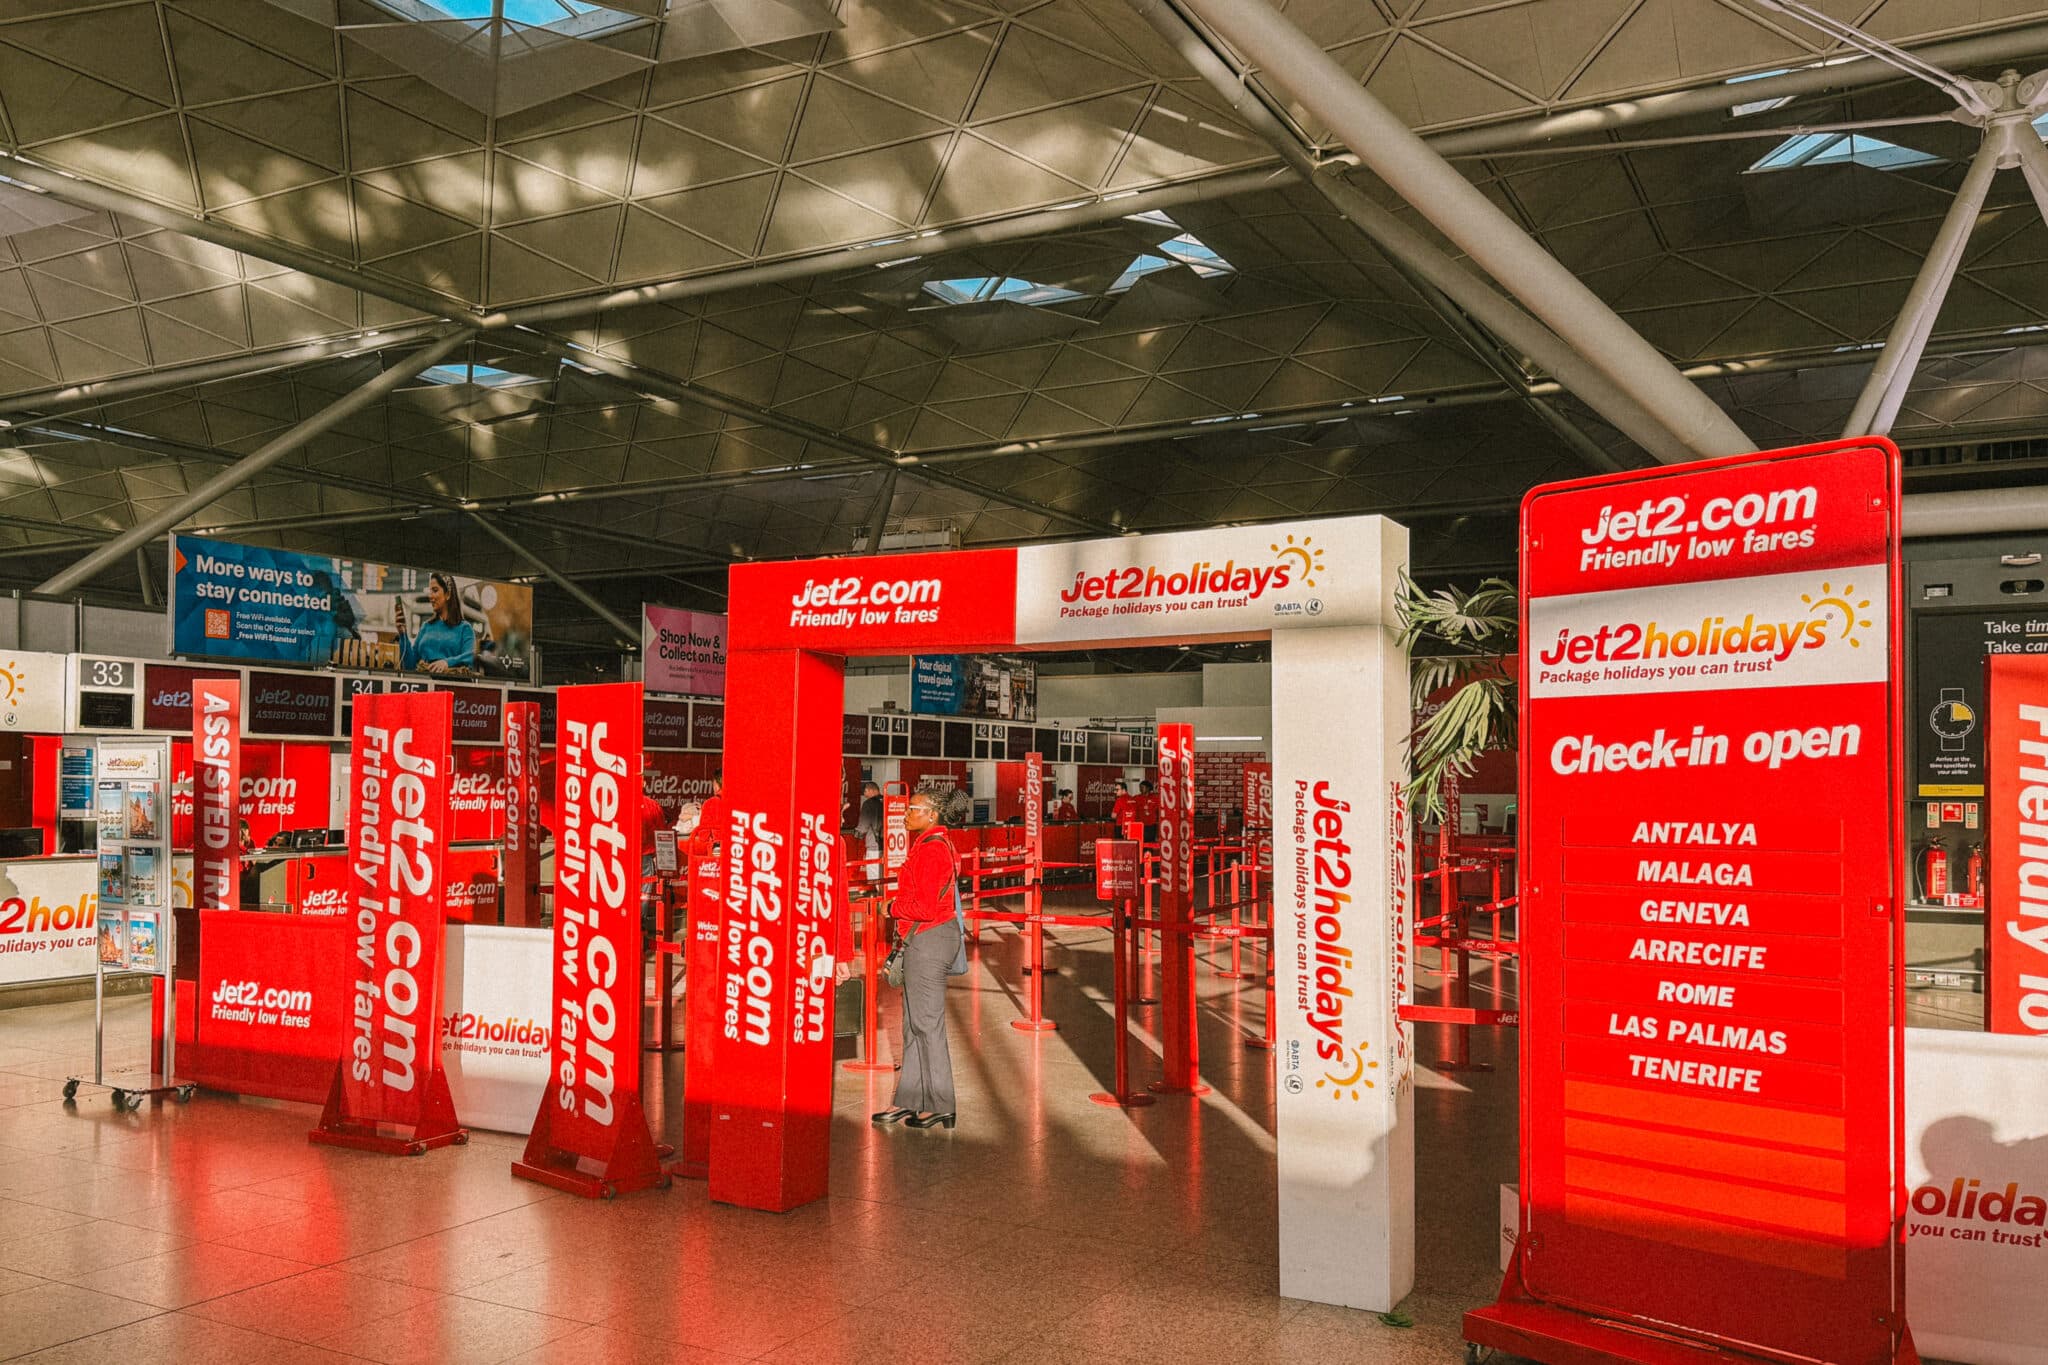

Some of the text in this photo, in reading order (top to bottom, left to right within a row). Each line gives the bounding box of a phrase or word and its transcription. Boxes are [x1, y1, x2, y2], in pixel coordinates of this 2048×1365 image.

[1581, 486, 1818, 545] Jet2.com
[1579, 525, 1816, 571] Friendly low fares
[196, 555, 314, 587] More ways to
[1060, 560, 1290, 603] Jet2holidays
[196, 582, 331, 611] stay connected
[792, 577, 942, 607] Jet2.com
[1060, 594, 1248, 618] Package holidays you can trust
[264, 624, 273, 632] QR
[790, 606, 940, 629] Friendly low fares
[1984, 620, 2020, 634] Take
[660, 628, 720, 648] Shop Now &
[1540, 614, 1827, 666] Jet2holidays
[1984, 640, 2021, 653] Take
[660, 646, 726, 664] Collect on Re
[918, 659, 952, 674] Your digital
[92, 662, 123, 686] 33
[918, 674, 952, 687] travel guide
[1540, 657, 1773, 684] Package holidays you can trust
[255, 688, 330, 708] Jet2.com
[256, 710, 328, 721] ASSISTED TRAVEL
[875, 718, 886, 730] 40
[895, 719, 904, 732] 41
[978, 725, 987, 737] 42
[994, 726, 1003, 738] 43
[1550, 724, 1861, 775] Check-in open
[204, 691, 230, 849] ASSISTED
[507, 712, 521, 850] Jet2.com
[529, 712, 540, 849] Jet2.com
[645, 776, 712, 794] Jet2.com
[1026, 759, 1040, 837] Jet2.com
[1246, 771, 1258, 818] Friendly
[258, 799, 296, 814] fares
[449, 796, 488, 812] riendly
[1160, 737, 1176, 892] Jet2.com
[1180, 737, 1193, 893] Jet2.com
[1632, 821, 1758, 846] ANTALYA
[1637, 860, 1754, 886] MALAGA
[353, 726, 388, 1082] Friendly low fares
[1292, 780, 1310, 1010] Package holidays you can trust
[383, 729, 435, 1092] Jet2.com
[559, 720, 587, 1111] Friendly low fares
[586, 722, 626, 1126] Jet2.com
[1306, 780, 1353, 1062] Jet2holidays
[1640, 899, 1750, 927] GENEVA
[724, 810, 750, 1042] Friendly low fares
[746, 813, 782, 1046] Jet2.com
[794, 812, 814, 1044] Friendly low fares
[50, 938, 74, 952] you
[1629, 938, 1768, 970] ARRECIFE
[212, 979, 312, 1012] Jet2.com
[1657, 980, 1736, 1008] ROME
[212, 1004, 311, 1028] Friendly low fares
[1608, 1013, 1788, 1055] LAS PALMAS
[454, 1041, 542, 1058] holidays you can trust
[1629, 1054, 1762, 1093] TENERIFE
[1912, 1177, 2048, 1227] olida
[1909, 1223, 2042, 1248] you can trust
